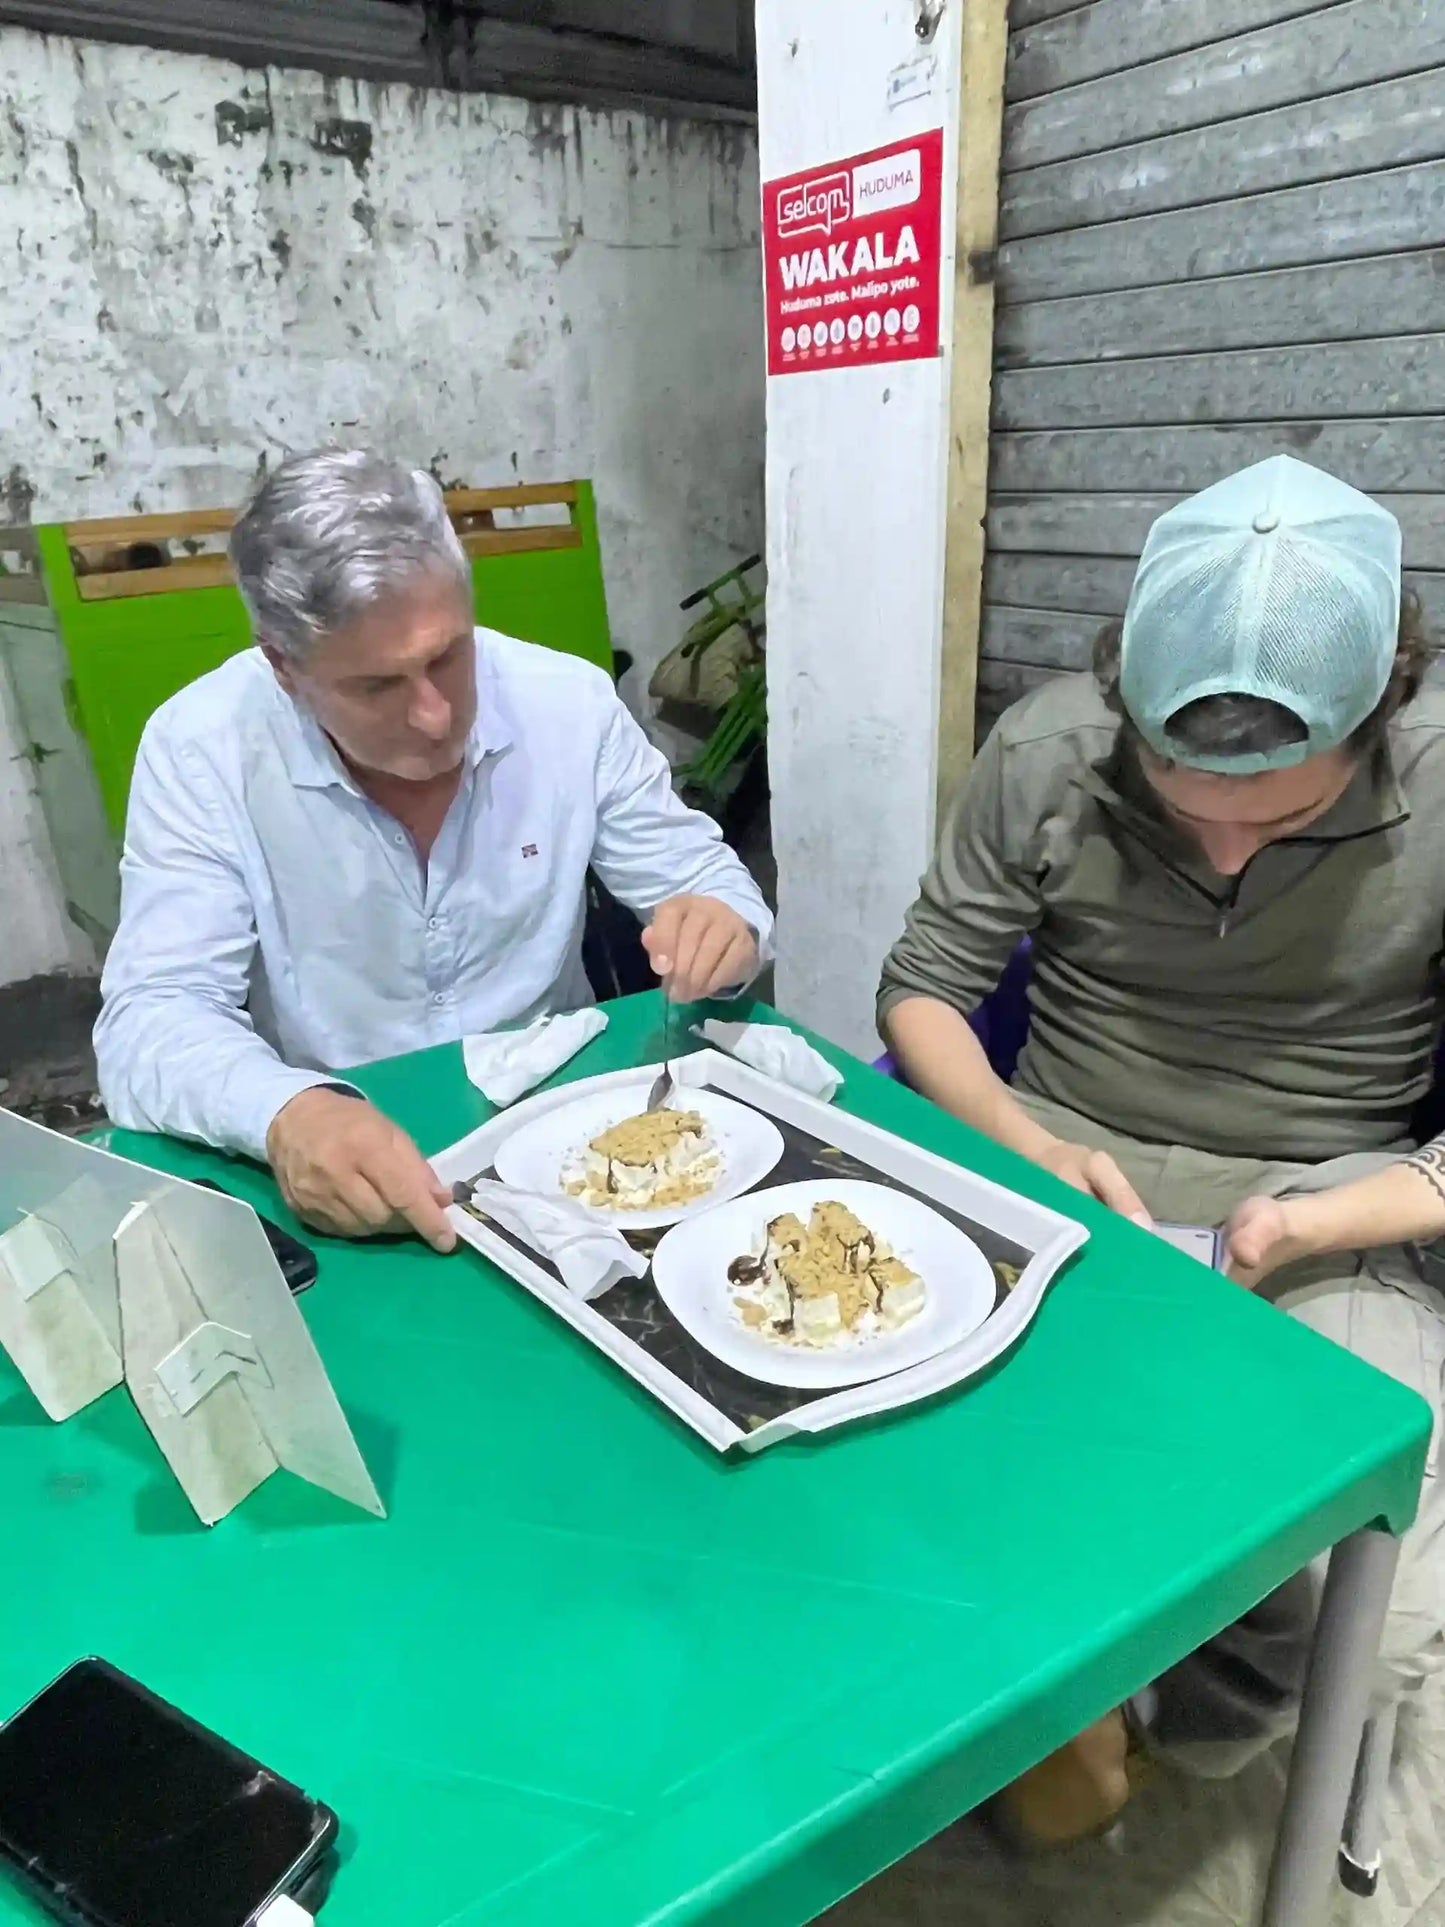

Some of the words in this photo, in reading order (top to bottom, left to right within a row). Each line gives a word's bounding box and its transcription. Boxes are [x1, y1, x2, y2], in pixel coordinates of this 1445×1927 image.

[859, 169, 914, 200] HUDUMA
[782, 183, 848, 223] selcom
[778, 225, 921, 291] WAKALA
[851, 280, 888, 300] Malipo
